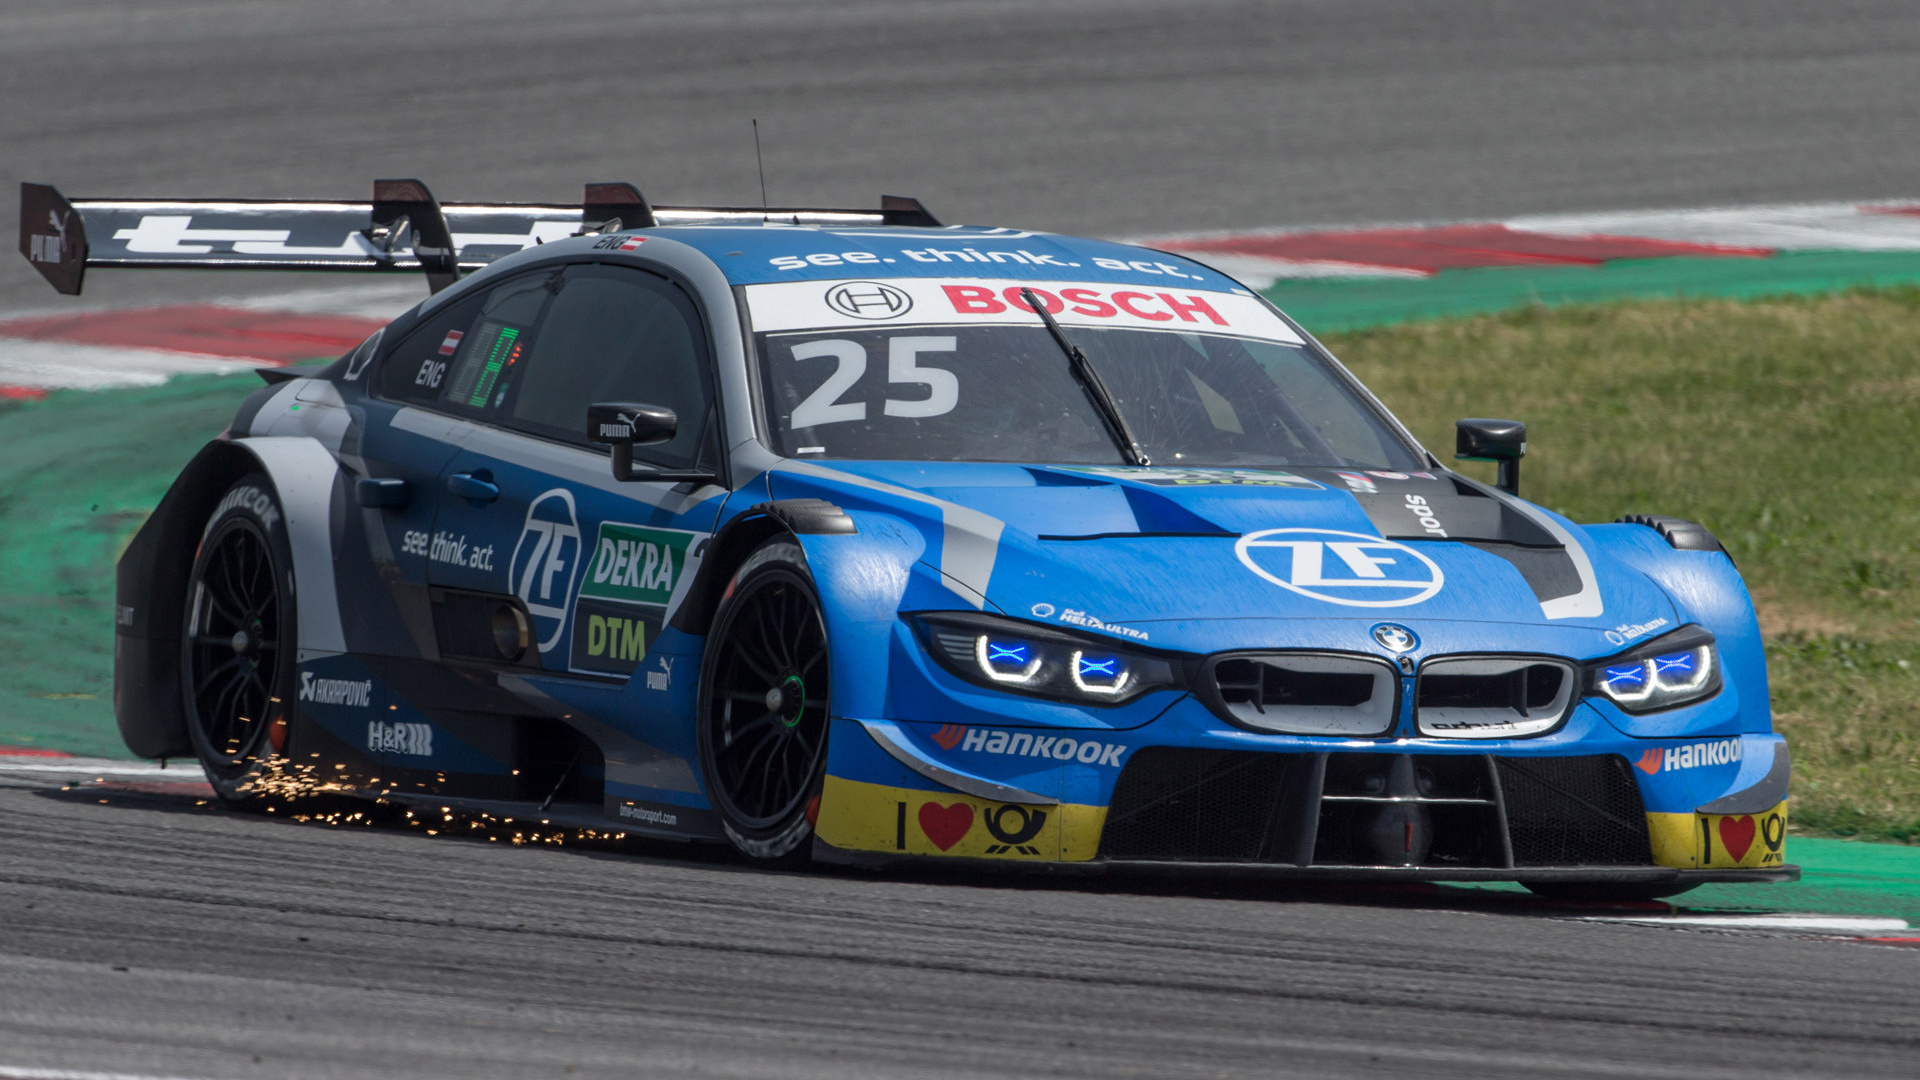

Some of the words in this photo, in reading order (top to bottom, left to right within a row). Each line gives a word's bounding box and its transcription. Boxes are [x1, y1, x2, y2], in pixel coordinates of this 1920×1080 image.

[592, 235, 632, 250] ENG
[769, 250, 896, 271] see.
[901, 247, 1081, 268] think.
[1094, 256, 1205, 281] act.
[940, 284, 1231, 327] BOSCH
[415, 359, 446, 388] ENG
[789, 335, 959, 430] 25
[600, 423, 630, 437] PUMA
[401, 530, 429, 556] see.
[429, 530, 467, 567] think.
[469, 544, 494, 572] act.
[593, 537, 673, 592] DEKRA
[588, 614, 646, 662] DTM
[647, 671, 668, 691] PUMA
[368, 720, 412, 755] H&R
